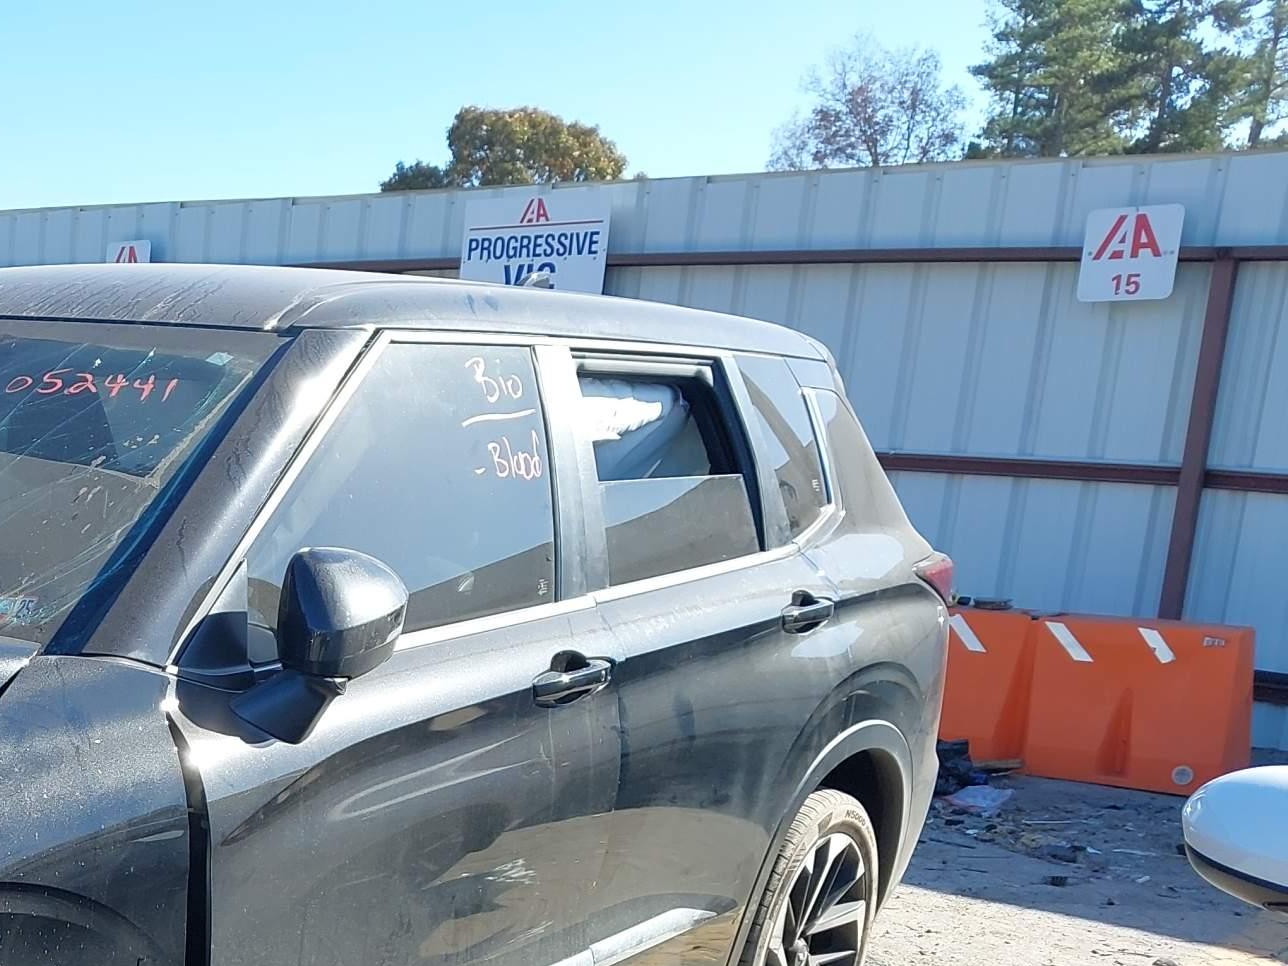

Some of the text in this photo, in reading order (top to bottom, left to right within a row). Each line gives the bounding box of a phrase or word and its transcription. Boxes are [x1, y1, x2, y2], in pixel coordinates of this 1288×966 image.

[467, 230, 601, 261] PROGRESSIVE
[1111, 273, 1141, 295] 15
[5, 368, 179, 402] 052441
[465, 357, 523, 403] Bio
